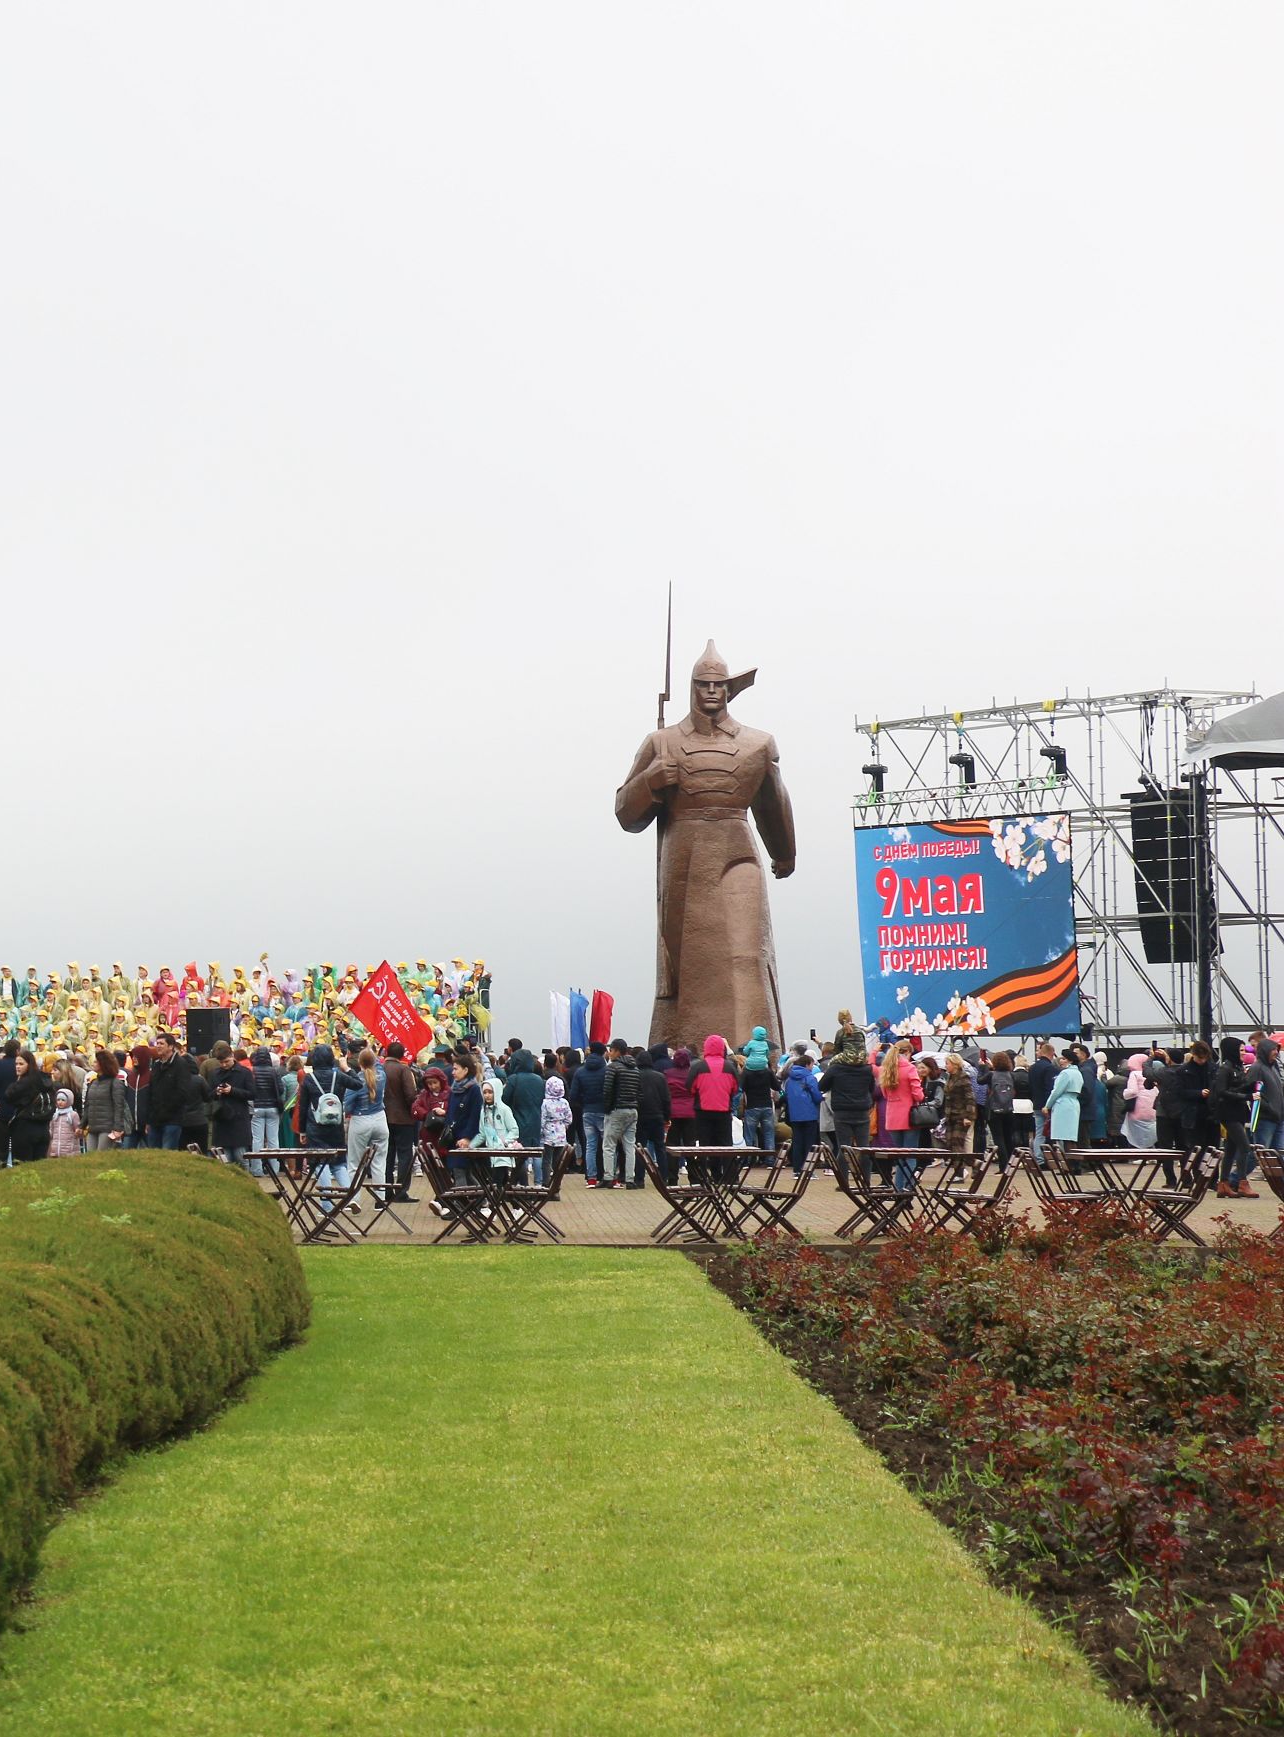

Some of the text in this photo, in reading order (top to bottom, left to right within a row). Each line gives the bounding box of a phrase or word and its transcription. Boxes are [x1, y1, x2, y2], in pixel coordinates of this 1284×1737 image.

[874, 839, 980, 861] С ДНЁМ ПОБЕДЫ!
[875, 867, 985, 919] 9мая
[878, 923, 969, 948] ПОМНИМ!
[880, 947, 989, 976] ГОРДИМСЯ!
